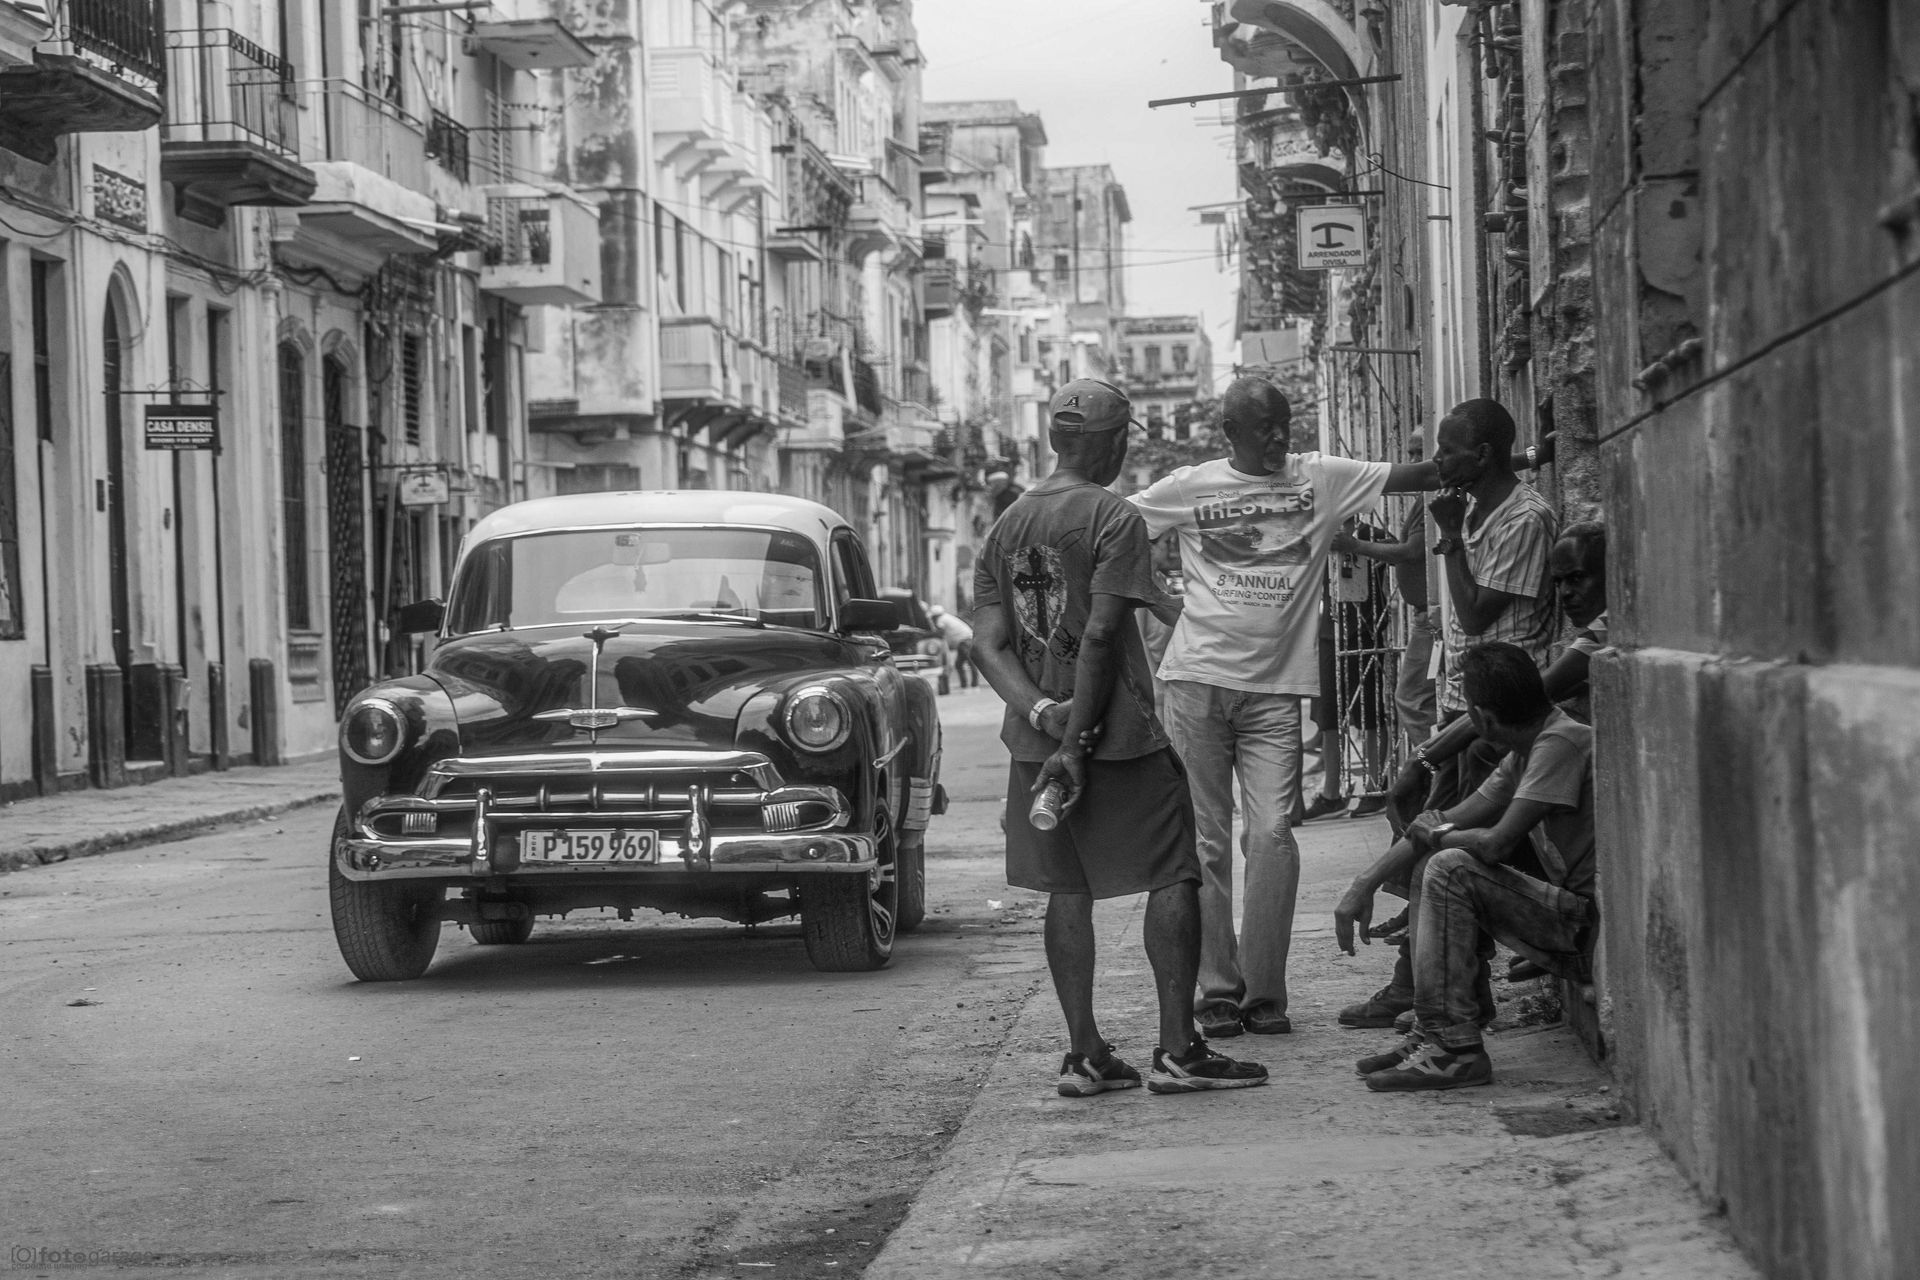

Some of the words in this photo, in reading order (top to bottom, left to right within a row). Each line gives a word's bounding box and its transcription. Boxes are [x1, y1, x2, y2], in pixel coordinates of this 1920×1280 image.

[1308, 249, 1361, 257] ARRENDADOR
[1322, 258, 1347, 266] DIVISA
[146, 420, 175, 433] CASA
[176, 421, 214, 433] DENSIL
[1235, 574, 1295, 591] ANNUAL
[1210, 587, 1252, 600] SURFING
[1256, 591, 1295, 602] CONTEST
[609, 836, 652, 860] 969
